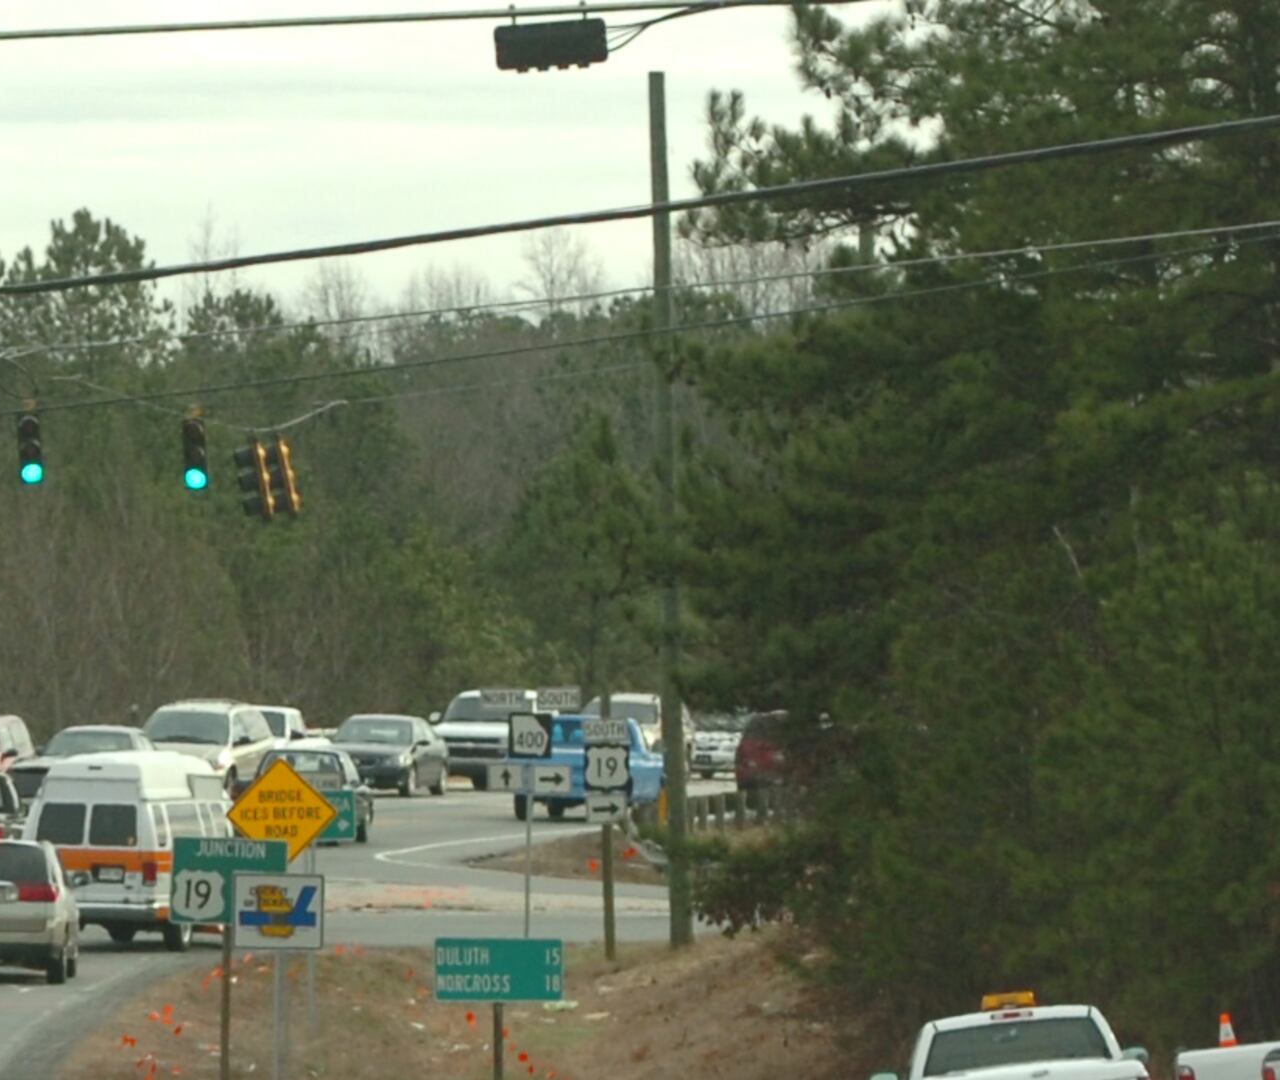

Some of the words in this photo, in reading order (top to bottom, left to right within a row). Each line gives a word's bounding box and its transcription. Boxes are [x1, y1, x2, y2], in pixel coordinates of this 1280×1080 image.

[482, 691, 523, 705] NORTH
[538, 690, 580, 705] SOUTH
[585, 722, 626, 737] SOUTH
[516, 731, 545, 748] 400
[596, 757, 618, 779] 19
[258, 789, 303, 803] BRIDGE
[241, 807, 269, 821] ICES
[272, 806, 322, 821] BEFORE
[264, 825, 299, 838] ROAD
[195, 841, 267, 859] JUNCTION
[184, 878, 213, 910] 19
[436, 947, 490, 966] DULUTH
[545, 947, 561, 966] 15
[436, 974, 511, 993] NORCROSS
[545, 974, 561, 992] 18
